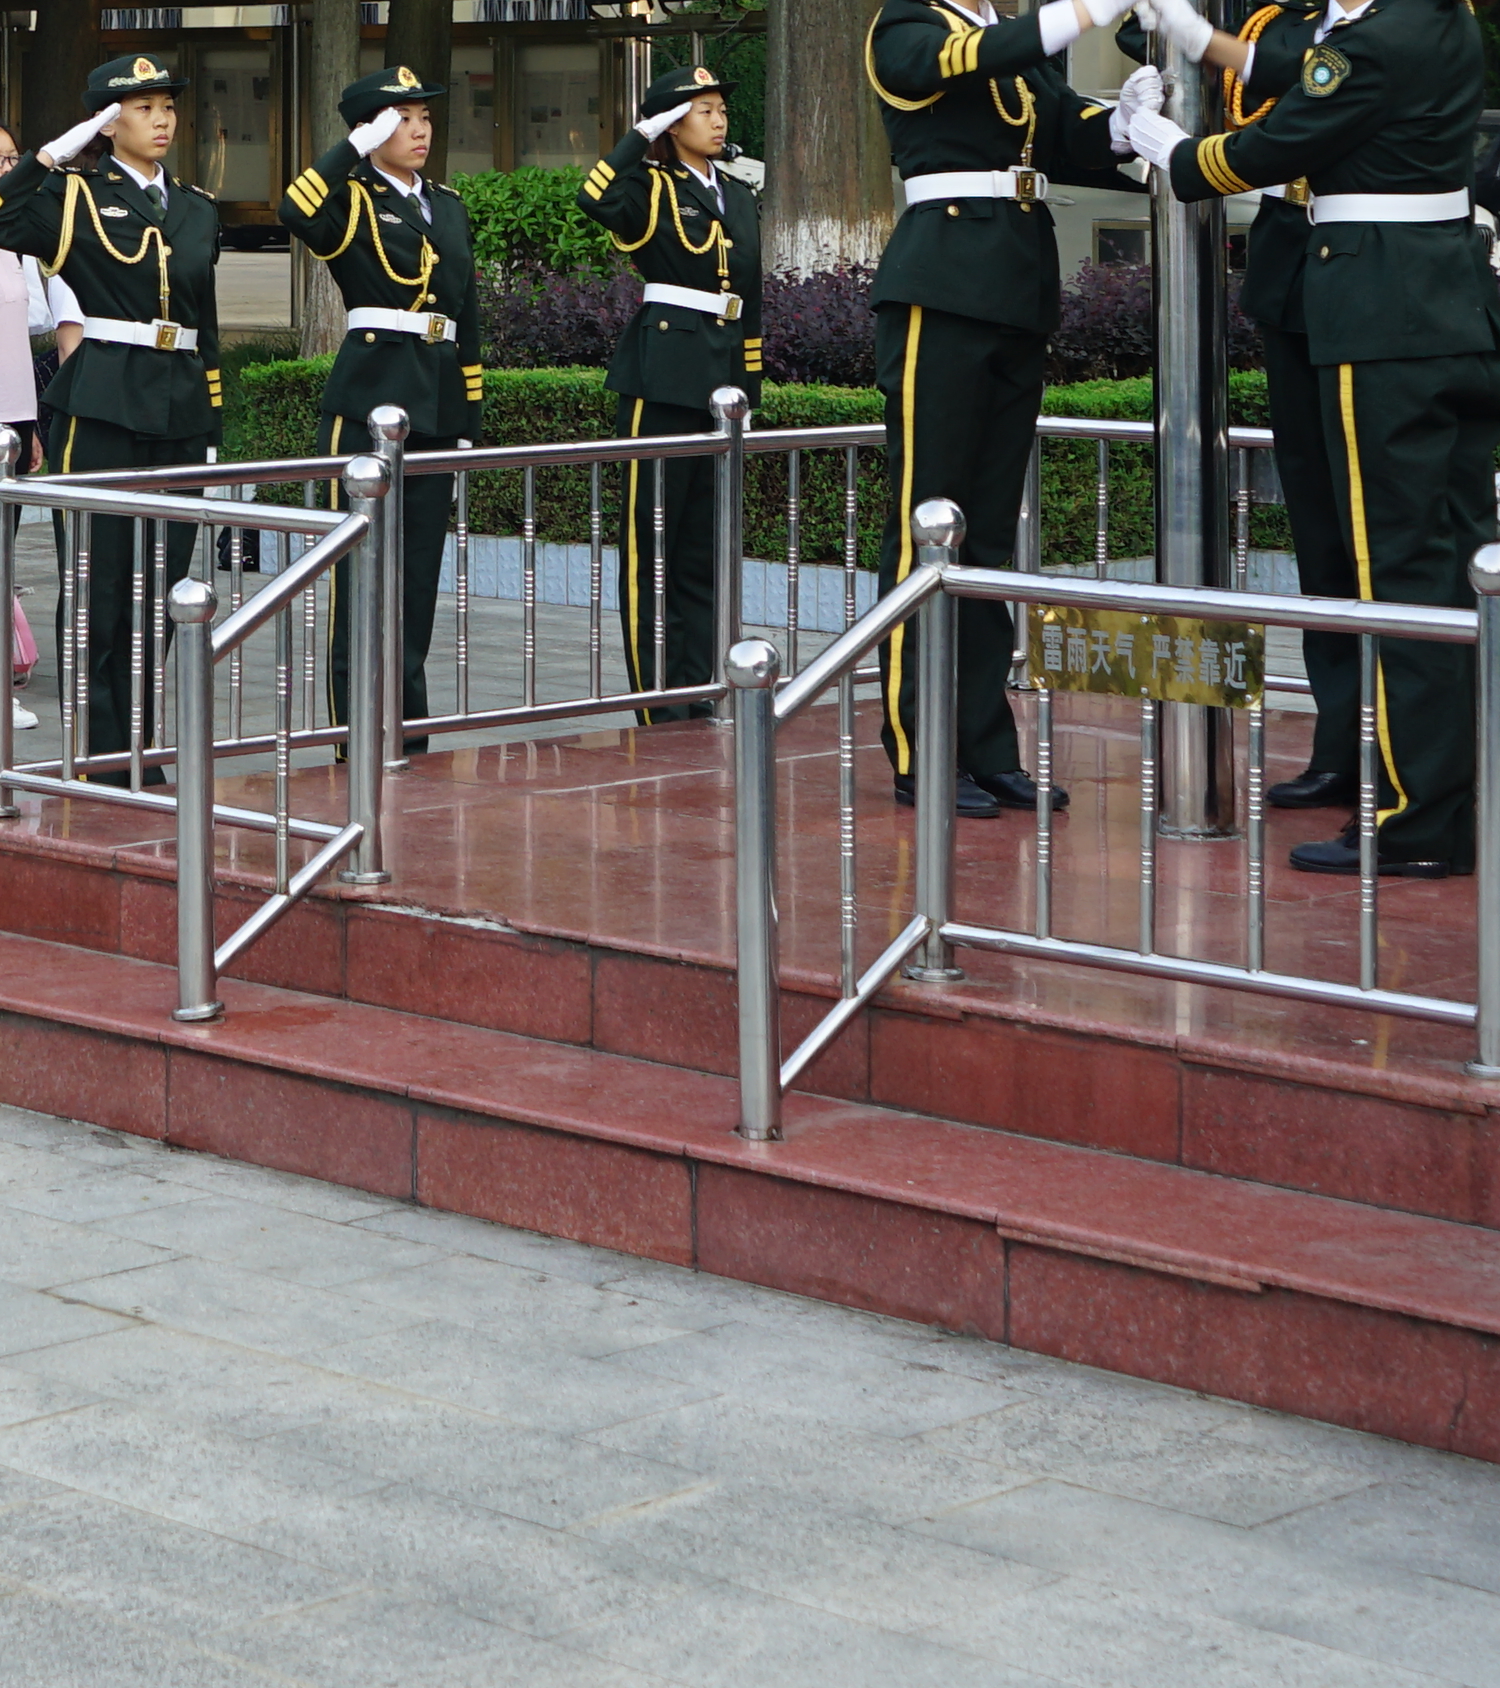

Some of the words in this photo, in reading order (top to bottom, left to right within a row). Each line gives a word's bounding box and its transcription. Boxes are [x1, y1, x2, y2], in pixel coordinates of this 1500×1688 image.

[1041, 624, 1137, 680] 雷雨天气
[1151, 634, 1248, 690] 严禁靠近
